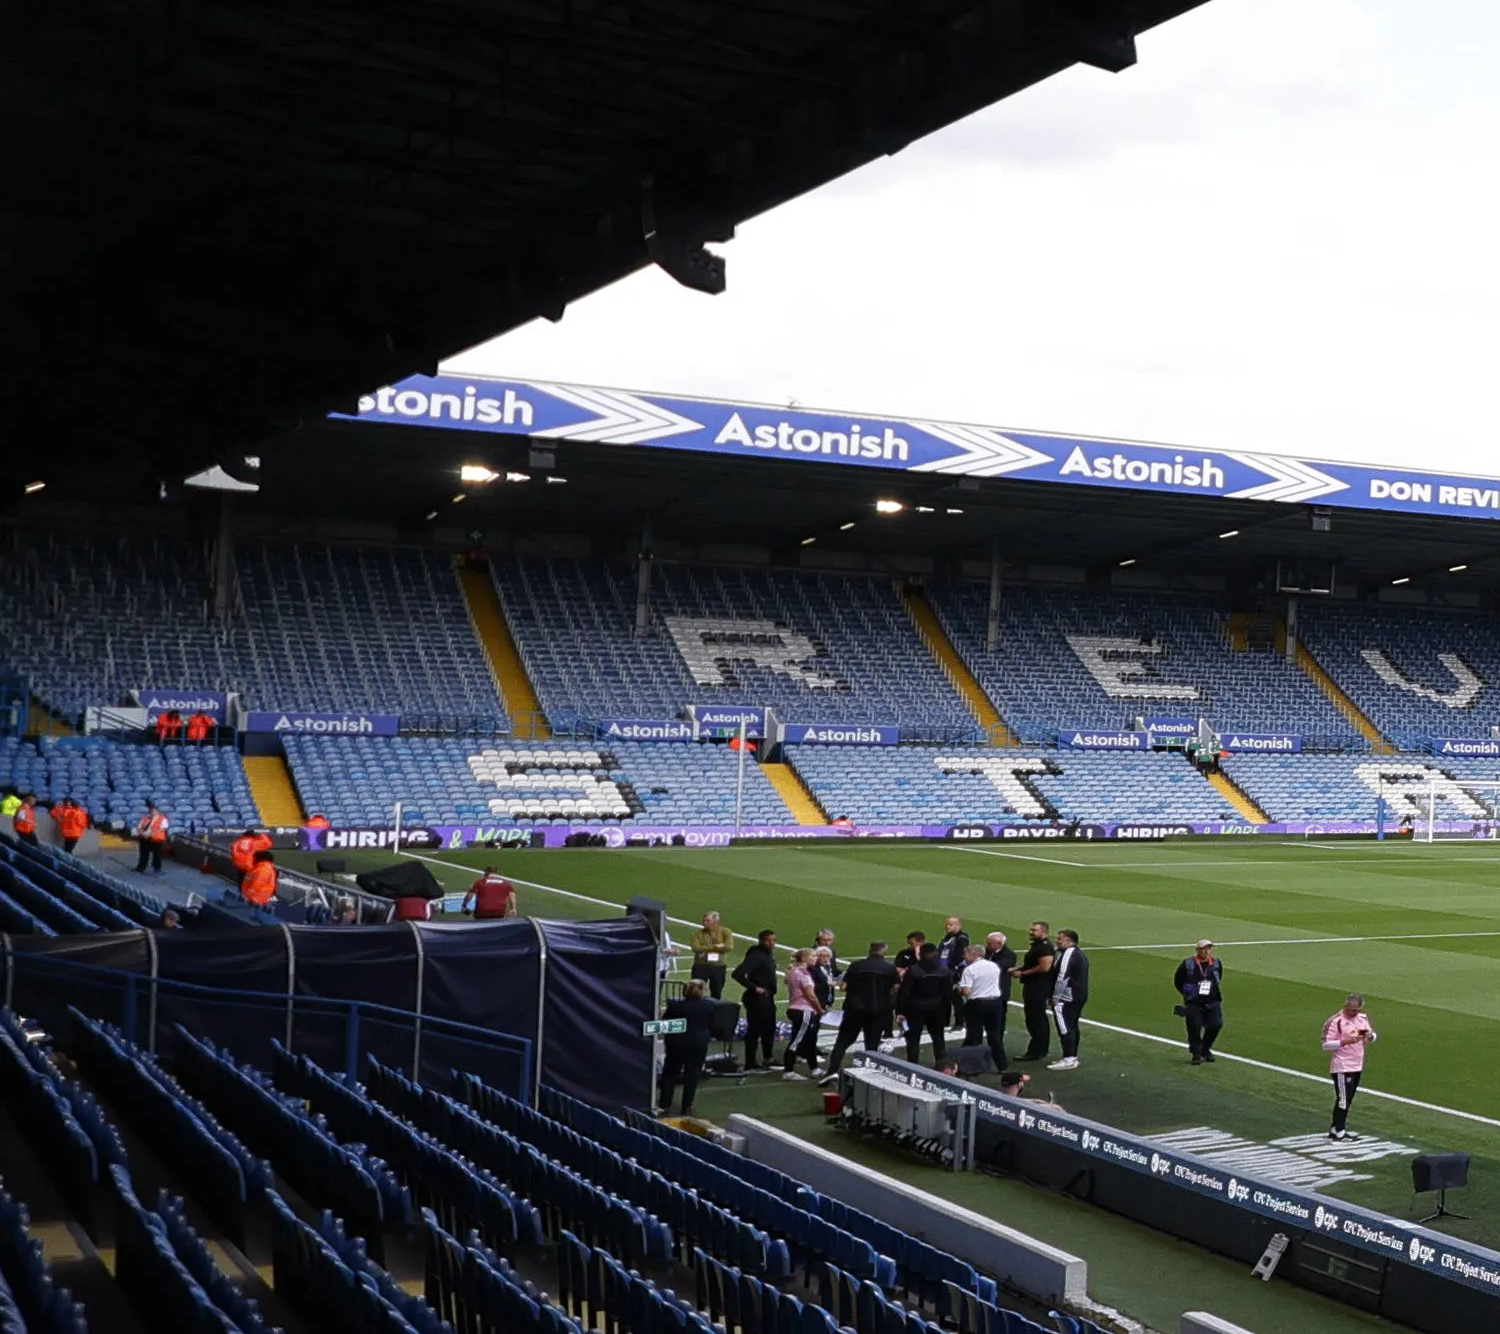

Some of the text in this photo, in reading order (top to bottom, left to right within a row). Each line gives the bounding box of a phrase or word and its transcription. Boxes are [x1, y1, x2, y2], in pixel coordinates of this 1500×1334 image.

[358, 386, 533, 426] stonish
[714, 412, 908, 461] Astonish
[1060, 446, 1223, 489] Astonish
[1370, 479, 1431, 502] DON
[148, 697, 219, 711] Astonish
[274, 715, 373, 733] Astonish
[702, 712, 759, 724] Astonish
[608, 722, 691, 738] Astonish
[803, 728, 881, 743] Astonish
[1149, 722, 1194, 734] Astonish
[1071, 733, 1140, 747] Astonish
[1229, 736, 1292, 749] Astonish
[1442, 741, 1499, 754] Astonish
[326, 830, 428, 848] HIRIG
